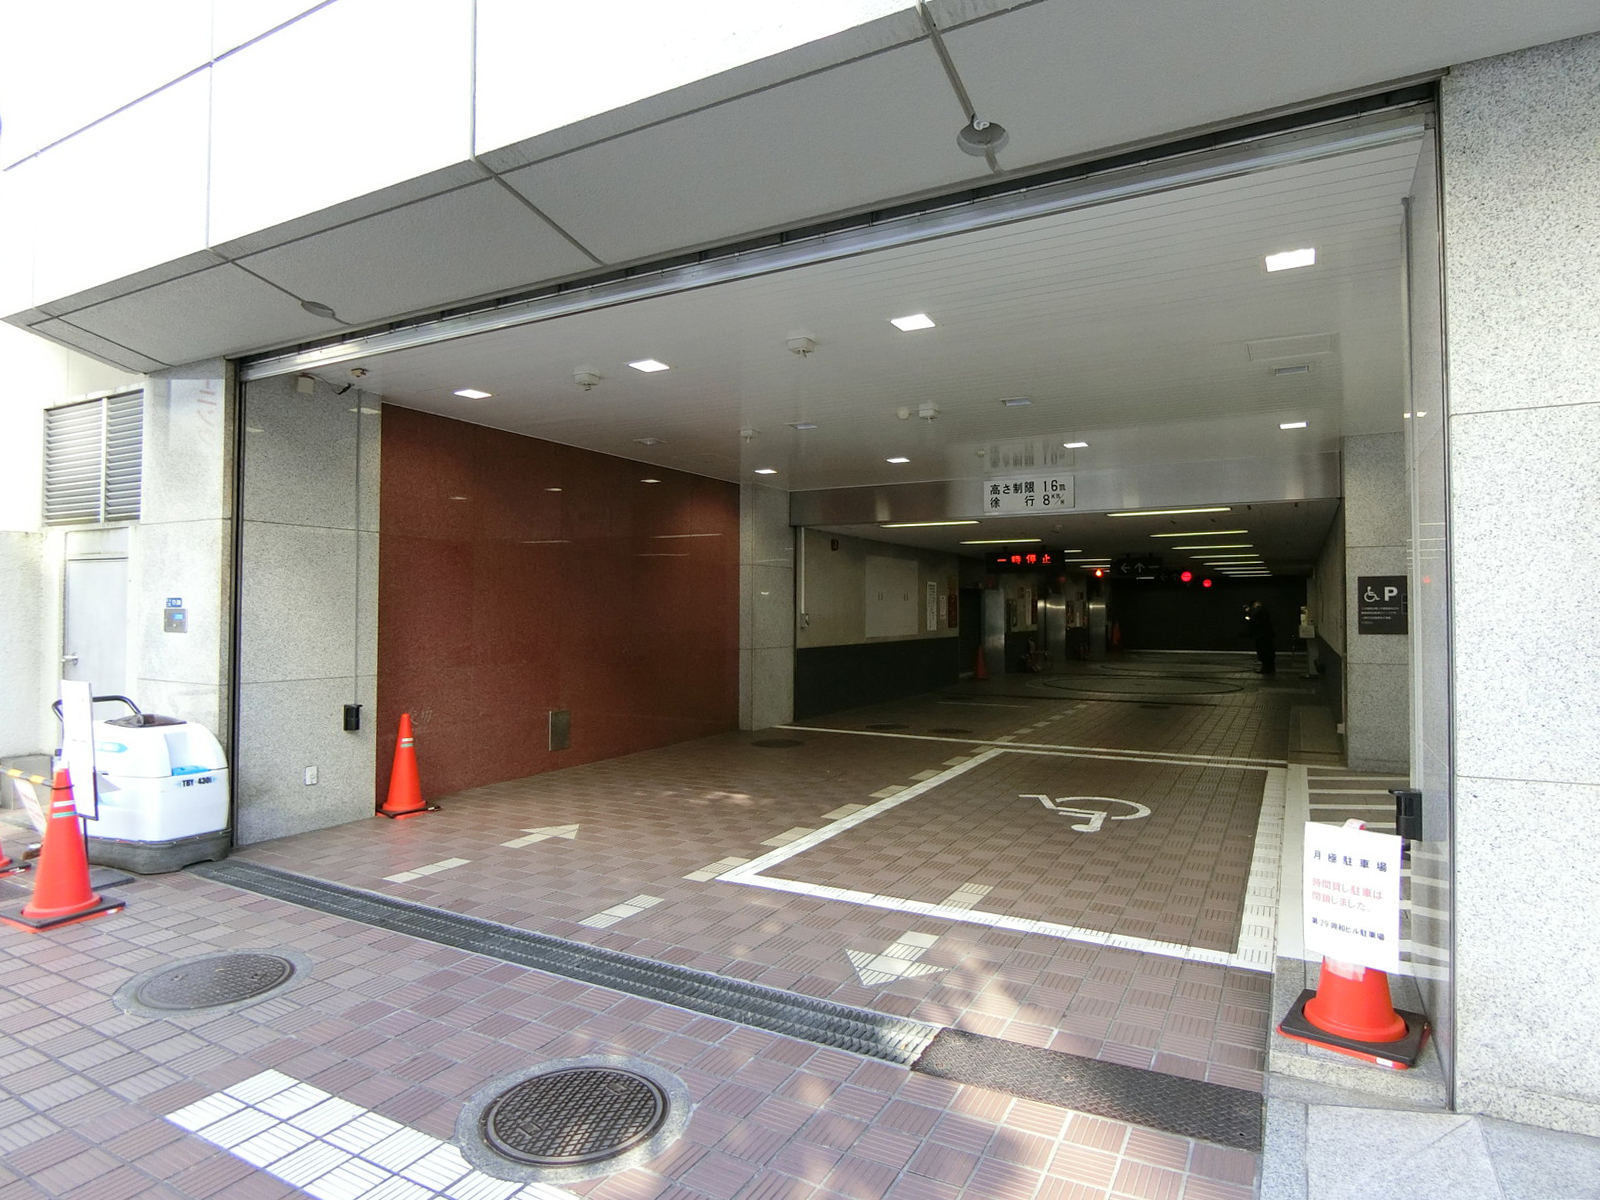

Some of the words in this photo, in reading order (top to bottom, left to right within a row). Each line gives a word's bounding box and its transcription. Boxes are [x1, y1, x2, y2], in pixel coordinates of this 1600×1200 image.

[990, 481, 1035, 495] 高さ制限
[997, 553, 1051, 565] 一時停止
[1384, 586, 1398, 602] P
[1313, 850, 1387, 872] 月極駐車場
[1312, 877, 1383, 900] 時間貸し駐車は
